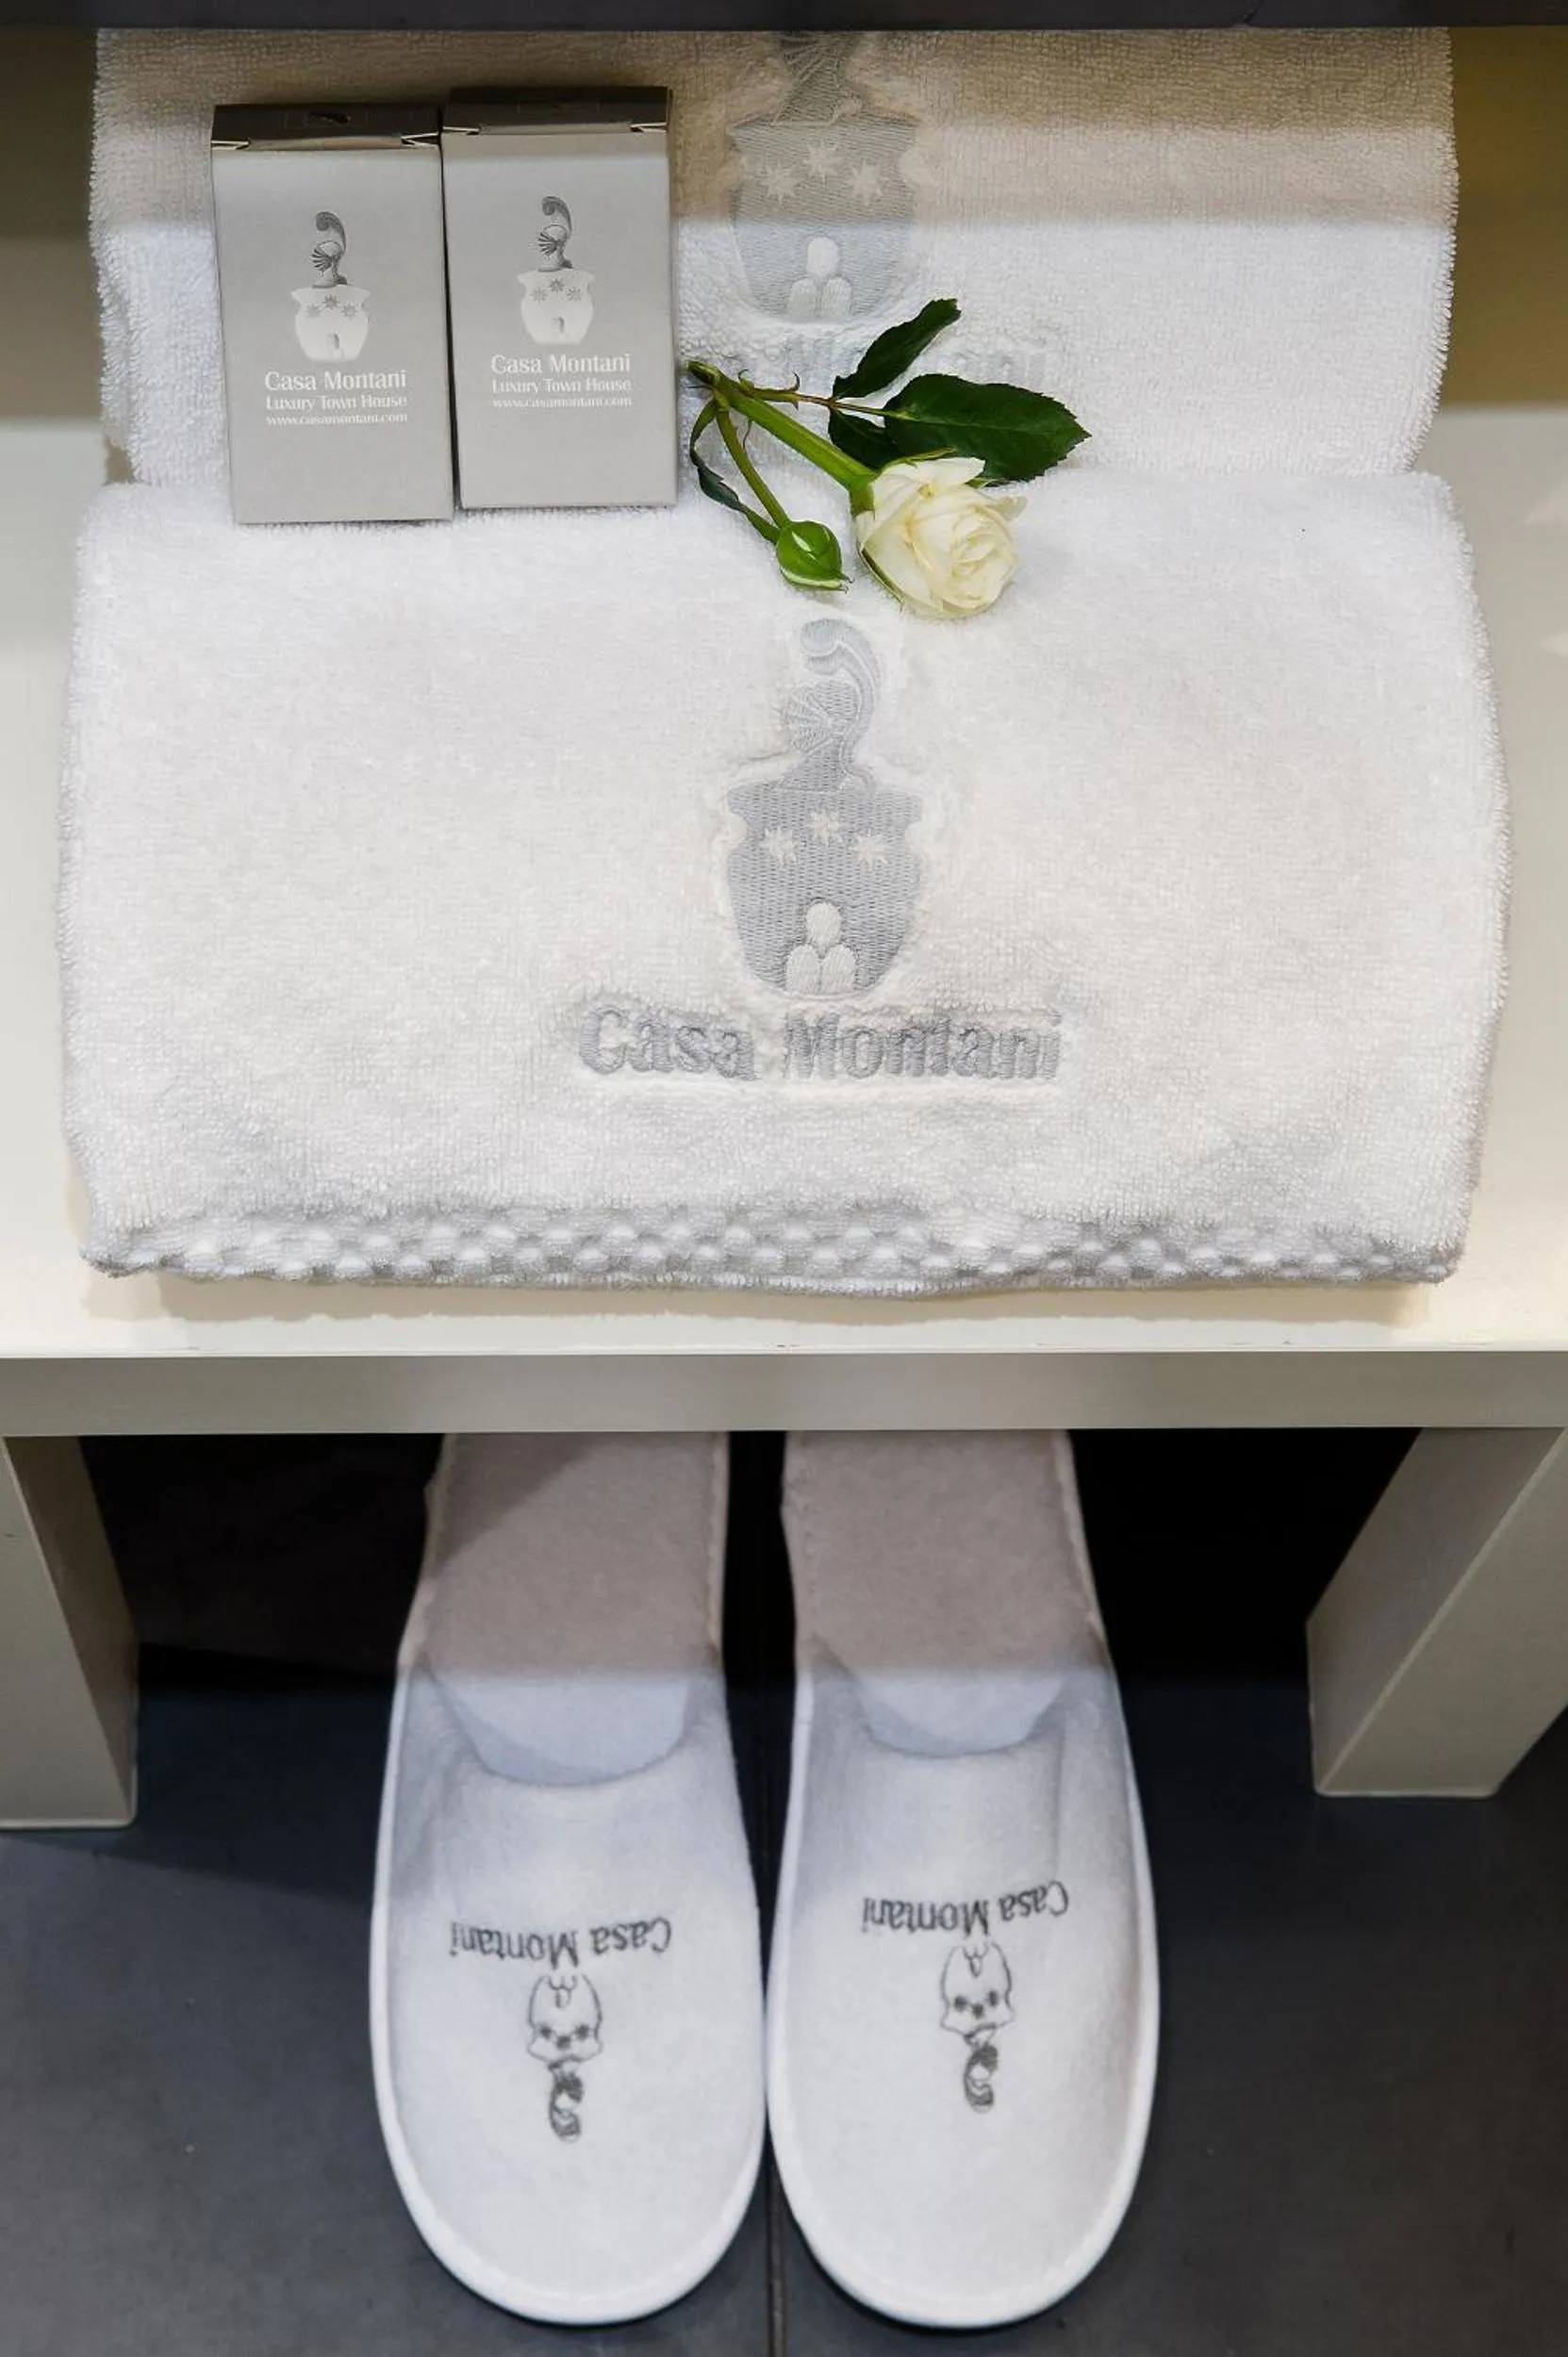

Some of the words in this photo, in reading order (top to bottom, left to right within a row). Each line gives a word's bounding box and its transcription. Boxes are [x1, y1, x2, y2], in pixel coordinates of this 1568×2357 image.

[490, 354, 542, 374] Casa
[550, 353, 631, 373] Montani
[264, 370, 317, 391] Casa
[322, 369, 407, 390] Montani
[491, 379, 540, 394] Luxury
[542, 377, 581, 392] Town
[586, 376, 632, 392] House
[265, 395, 315, 411] Luxury
[319, 394, 356, 410] Town
[361, 392, 407, 408] House
[265, 412, 408, 425] www.casamontani.com
[579, 1005, 756, 1081] Casa
[784, 1009, 1063, 1080] Montani
[999, 1880, 1069, 1921] Casa
[862, 1897, 990, 1937] Montani
[449, 1920, 579, 1970] Montani
[589, 1916, 671, 1956] Casa
